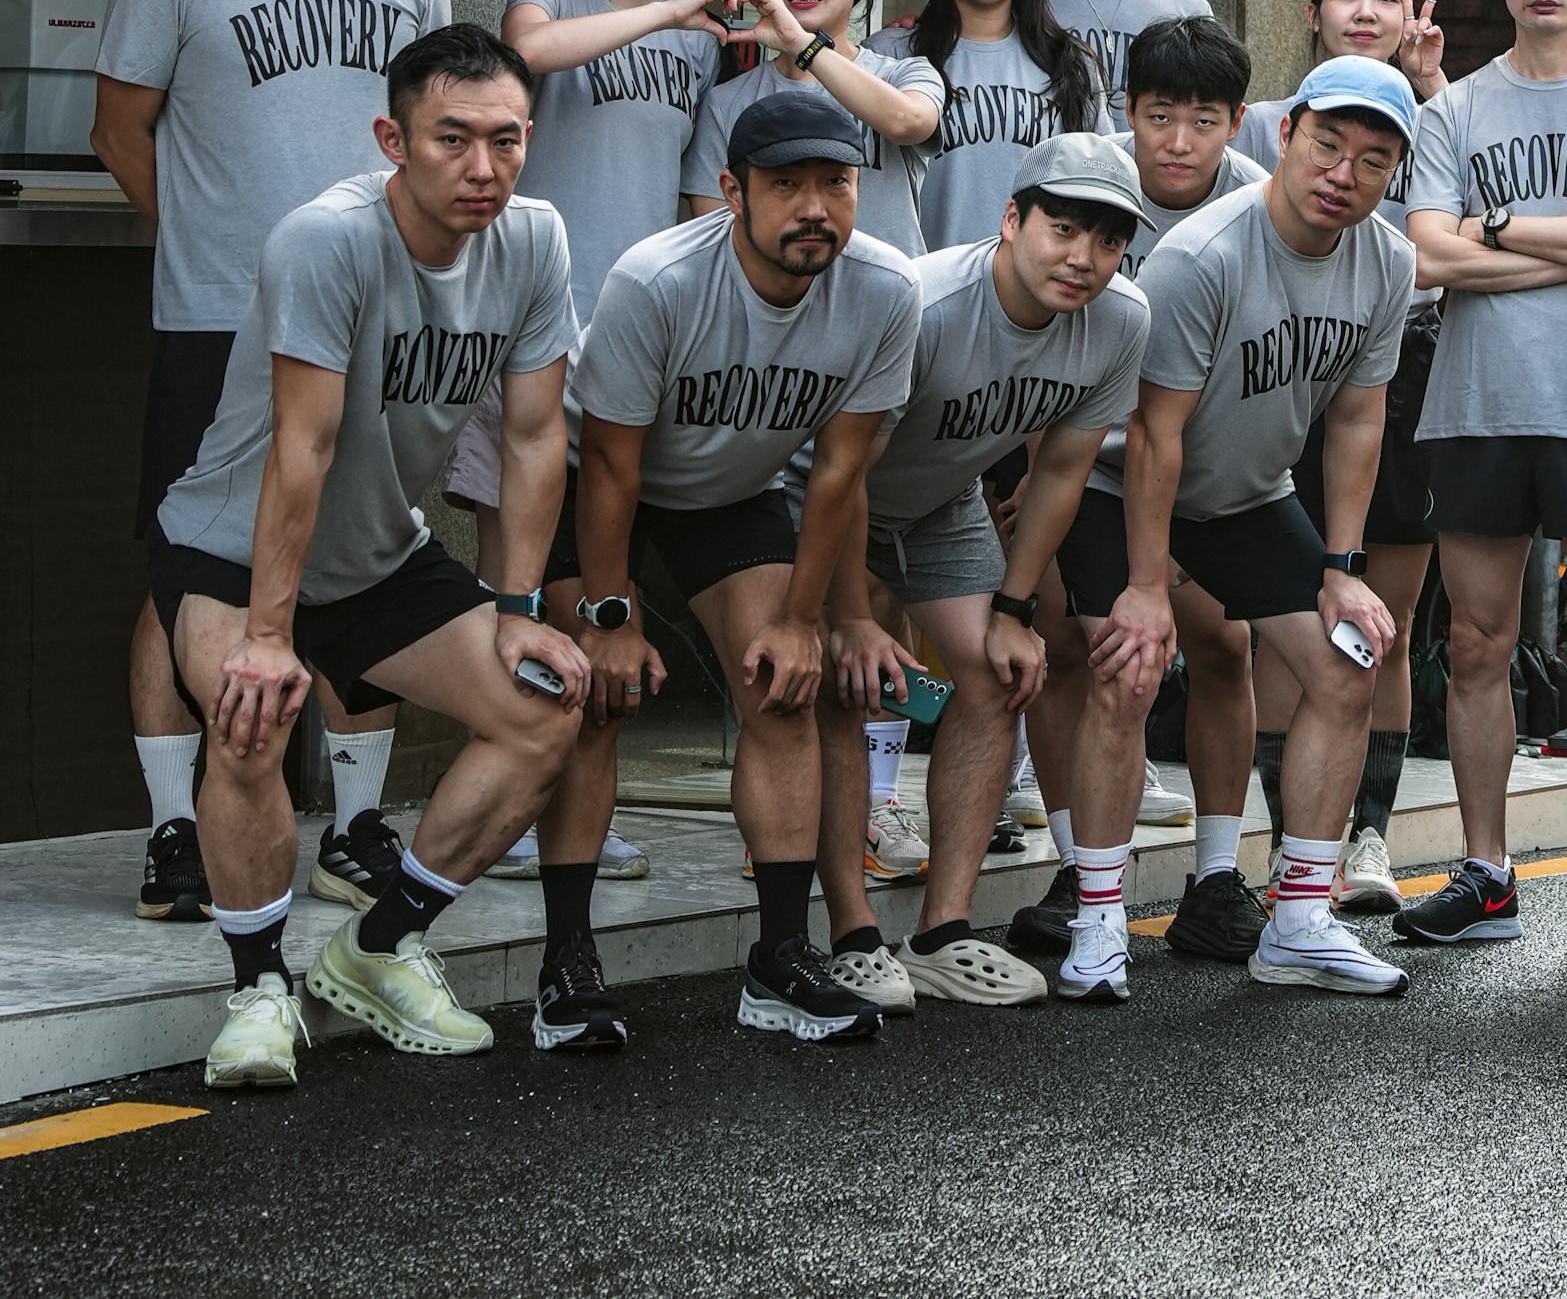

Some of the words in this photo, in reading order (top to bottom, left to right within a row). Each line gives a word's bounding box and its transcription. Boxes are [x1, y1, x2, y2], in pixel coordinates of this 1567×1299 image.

[585, 43, 701, 120] RECOVER
[935, 84, 1061, 160] ECOVERY
[675, 363, 846, 432] RECOVERY
